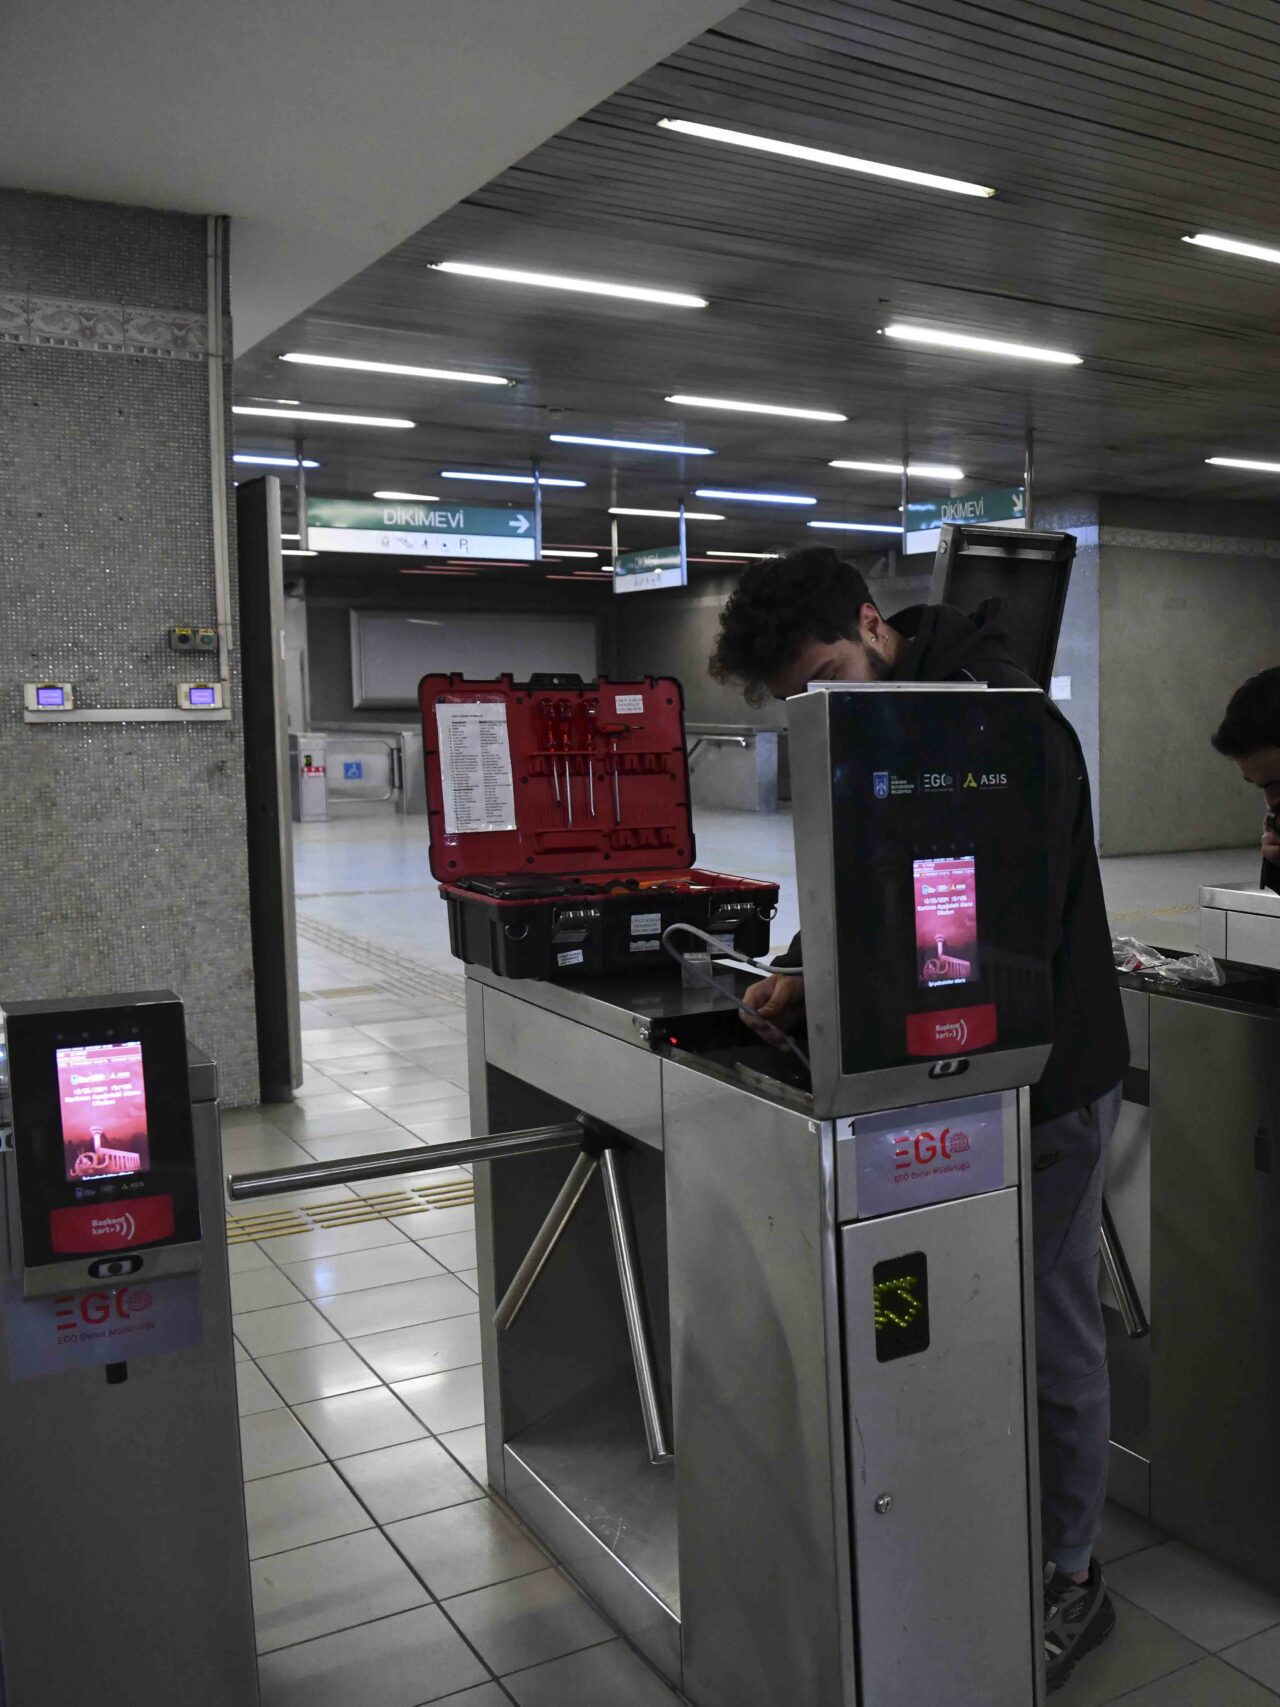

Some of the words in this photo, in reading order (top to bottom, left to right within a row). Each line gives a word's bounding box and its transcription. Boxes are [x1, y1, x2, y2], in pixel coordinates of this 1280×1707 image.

[382, 506, 464, 528] DİKİMEVİ
[941, 496, 984, 520] DİKİMEVİ
[924, 773, 953, 788] EGO
[980, 773, 1008, 786] ASIS
[895, 1128, 970, 1170] EGO
[54, 1286, 152, 1331] EGO
